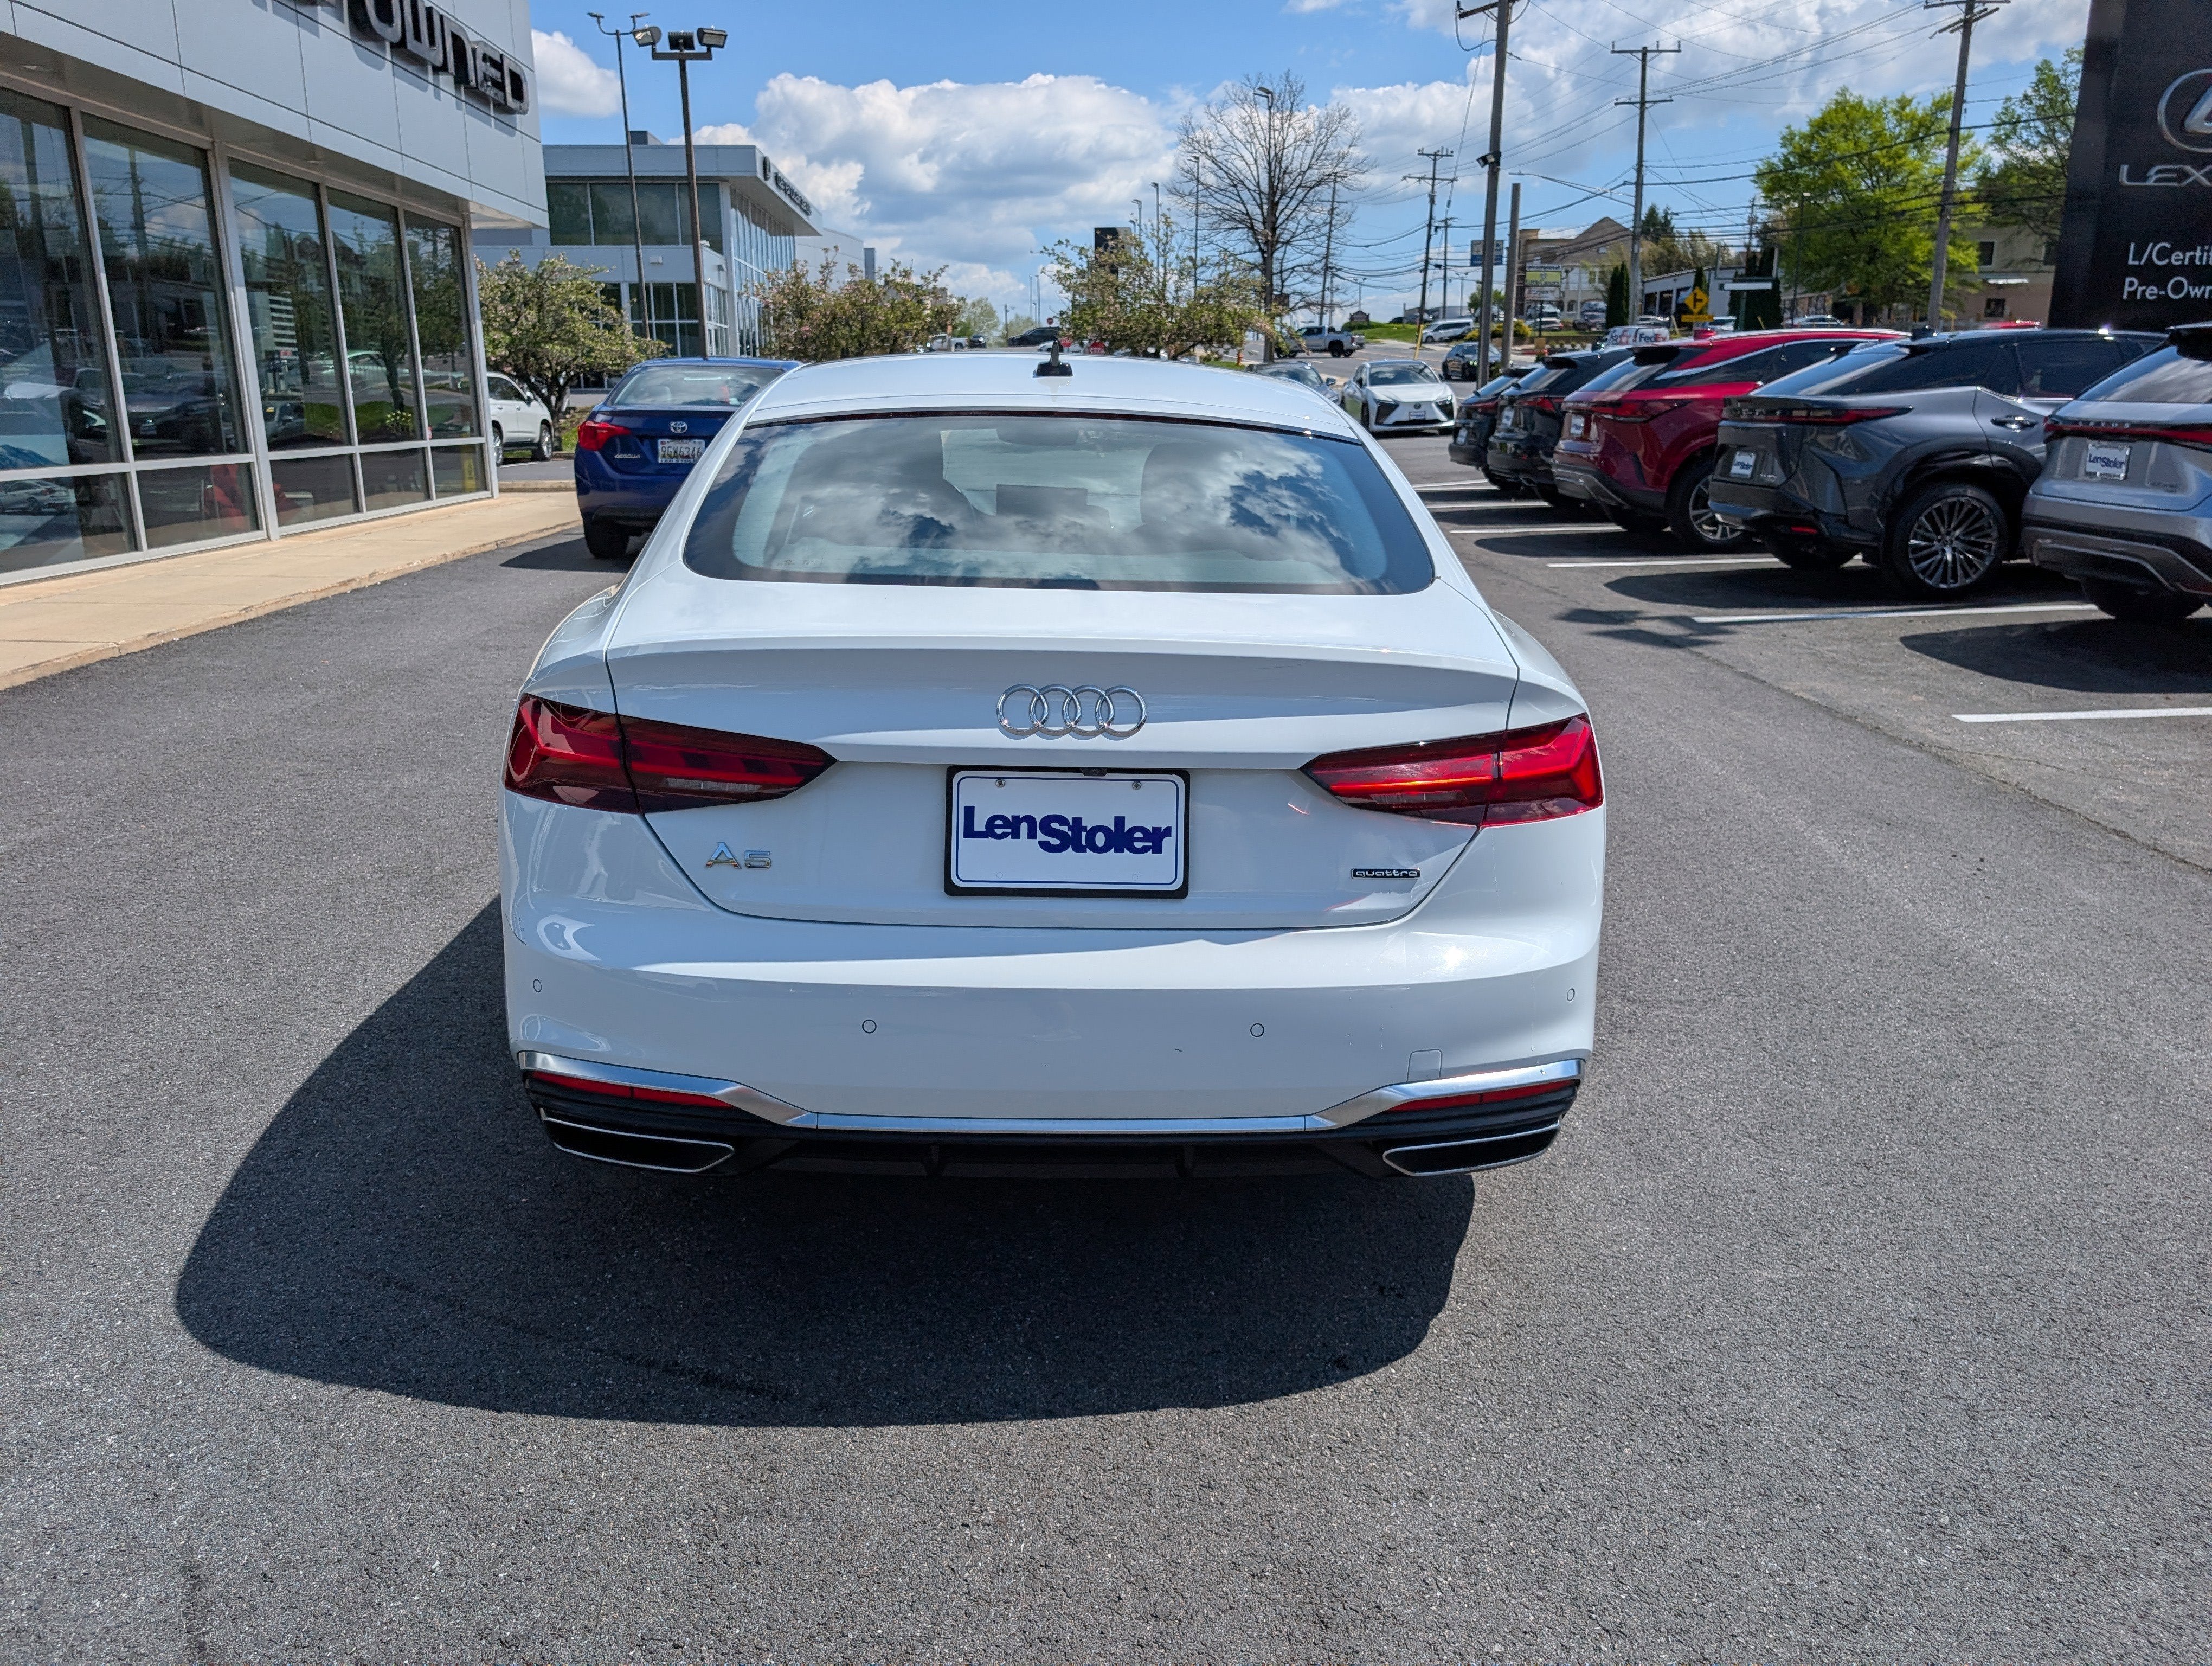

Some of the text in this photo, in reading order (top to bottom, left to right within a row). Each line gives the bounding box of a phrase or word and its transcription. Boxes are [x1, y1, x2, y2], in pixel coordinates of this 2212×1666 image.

[2127, 242, 2212, 266] L/Certi
[1639, 333, 1667, 343] FedEx
[963, 805, 1172, 854] LenStoler
[704, 842, 772, 869] A5
